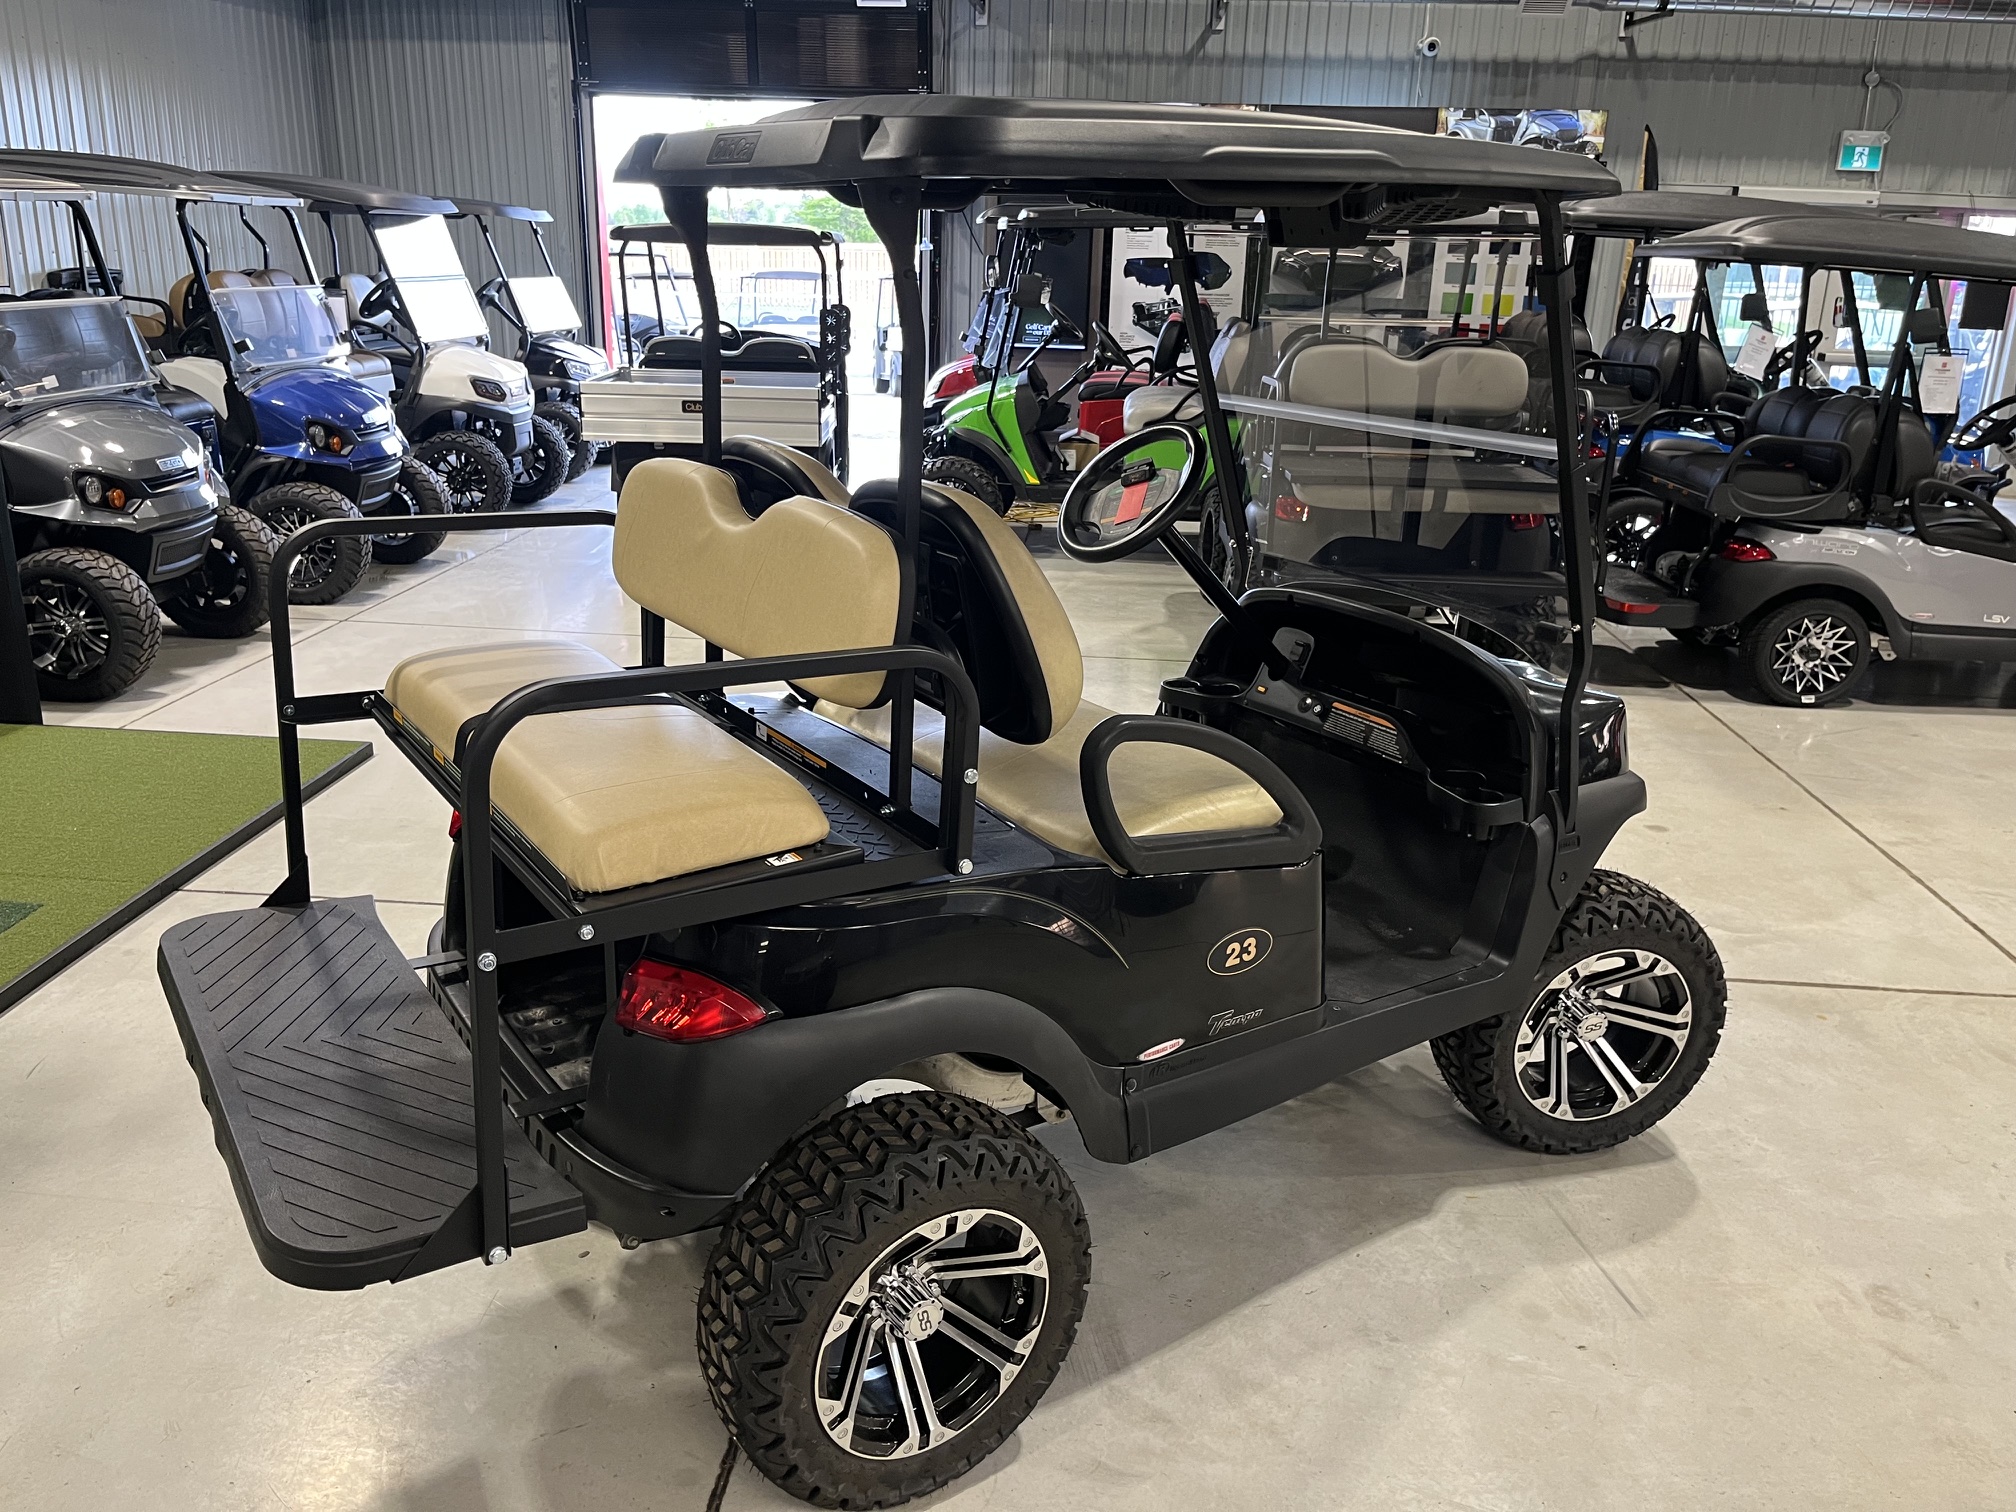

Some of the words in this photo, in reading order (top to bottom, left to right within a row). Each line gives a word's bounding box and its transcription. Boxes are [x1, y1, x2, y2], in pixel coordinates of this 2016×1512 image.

[685, 402, 703, 411] Club
[1983, 613, 2011, 624] LSV
[1225, 937, 1257, 968] 23
[1208, 1008, 1264, 1036] Tempo
[1584, 1021, 1603, 1034] SS
[916, 1309, 933, 1332] SS
